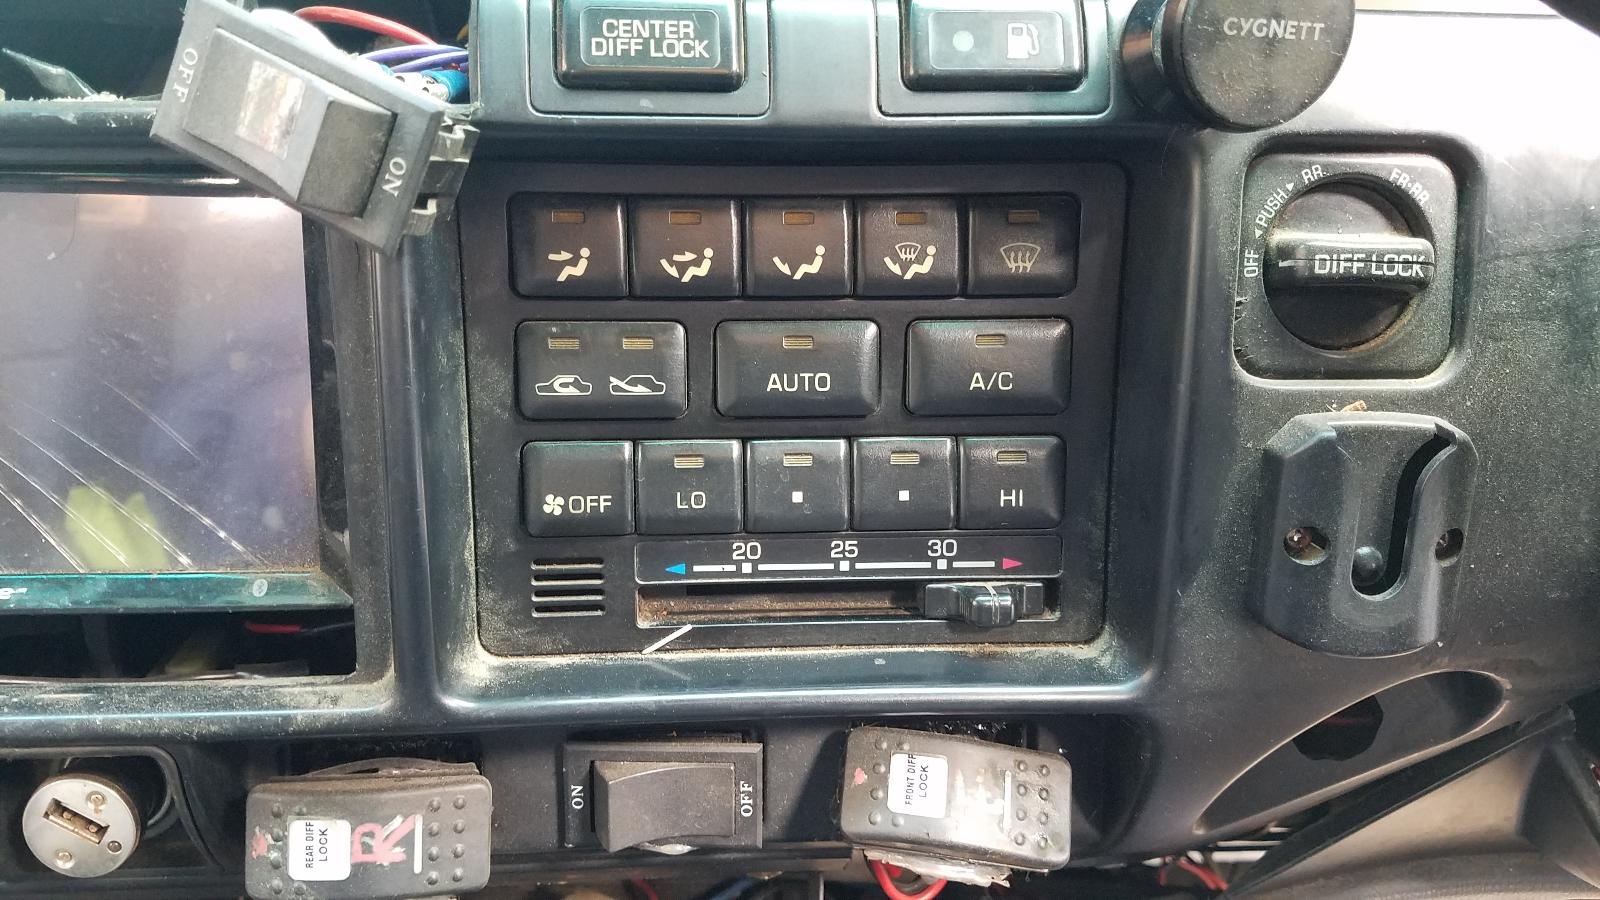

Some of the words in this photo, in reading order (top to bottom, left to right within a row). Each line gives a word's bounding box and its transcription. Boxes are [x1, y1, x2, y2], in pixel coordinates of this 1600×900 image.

[602, 19, 695, 39] CENTER
[1223, 17, 1326, 41] CYGNETT
[591, 38, 644, 57] DIFF
[650, 39, 710, 58] LOCK
[172, 47, 199, 103] OFF
[382, 156, 407, 197] ON
[1255, 187, 1289, 228] PUSH
[1243, 249, 1260, 279] OFF
[1313, 253, 1367, 275] DIFF
[1371, 254, 1427, 278] LOCK
[766, 372, 832, 393] AUTO
[969, 371, 1014, 391] A/C
[568, 495, 613, 514] OFF
[676, 491, 706, 510] LO
[1000, 487, 1023, 507] HI
[731, 541, 762, 560] 20
[830, 540, 859, 559] 25
[926, 538, 957, 558] 30
[907, 753, 917, 774] DIFF
[904, 776, 916, 806] FRONT
[918, 764, 930, 798] LOCK
[570, 784, 585, 811] ON
[739, 780, 754, 818] OFF
[305, 821, 315, 842] DIFF
[318, 827, 329, 862] LOCK
[305, 844, 315, 869] REAR
